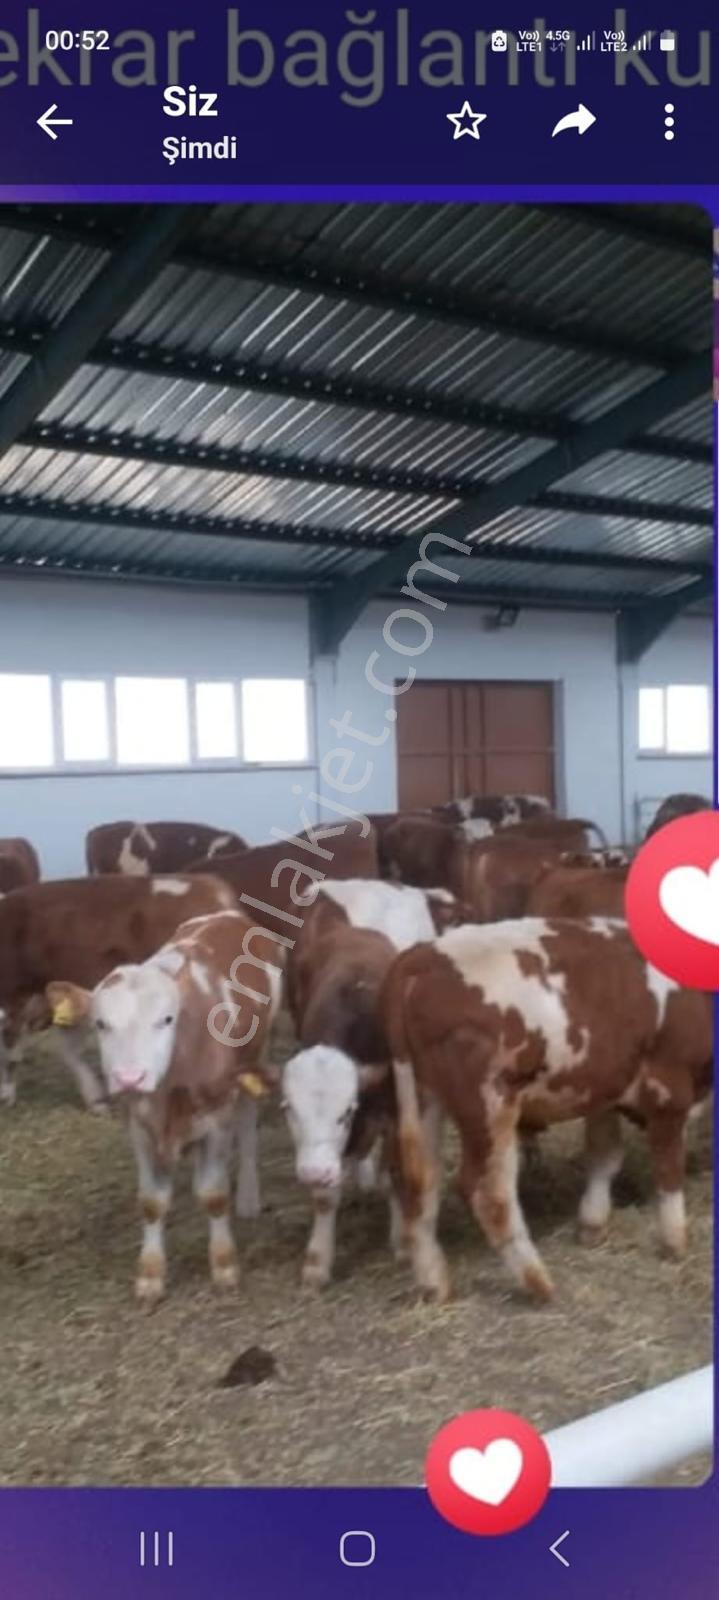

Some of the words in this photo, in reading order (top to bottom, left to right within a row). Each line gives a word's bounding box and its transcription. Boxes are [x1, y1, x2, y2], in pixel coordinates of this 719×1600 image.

[45, 30, 110, 51] 00:52
[545, 30, 571, 41] 4.5G
[227, 8, 576, 107] bağlantı
[614, 8, 711, 87] ku
[516, 42, 542, 52] LTE1
[600, 42, 628, 52] LTE2
[162, 84, 219, 117] Siz
[162, 135, 237, 166] Şimdi
